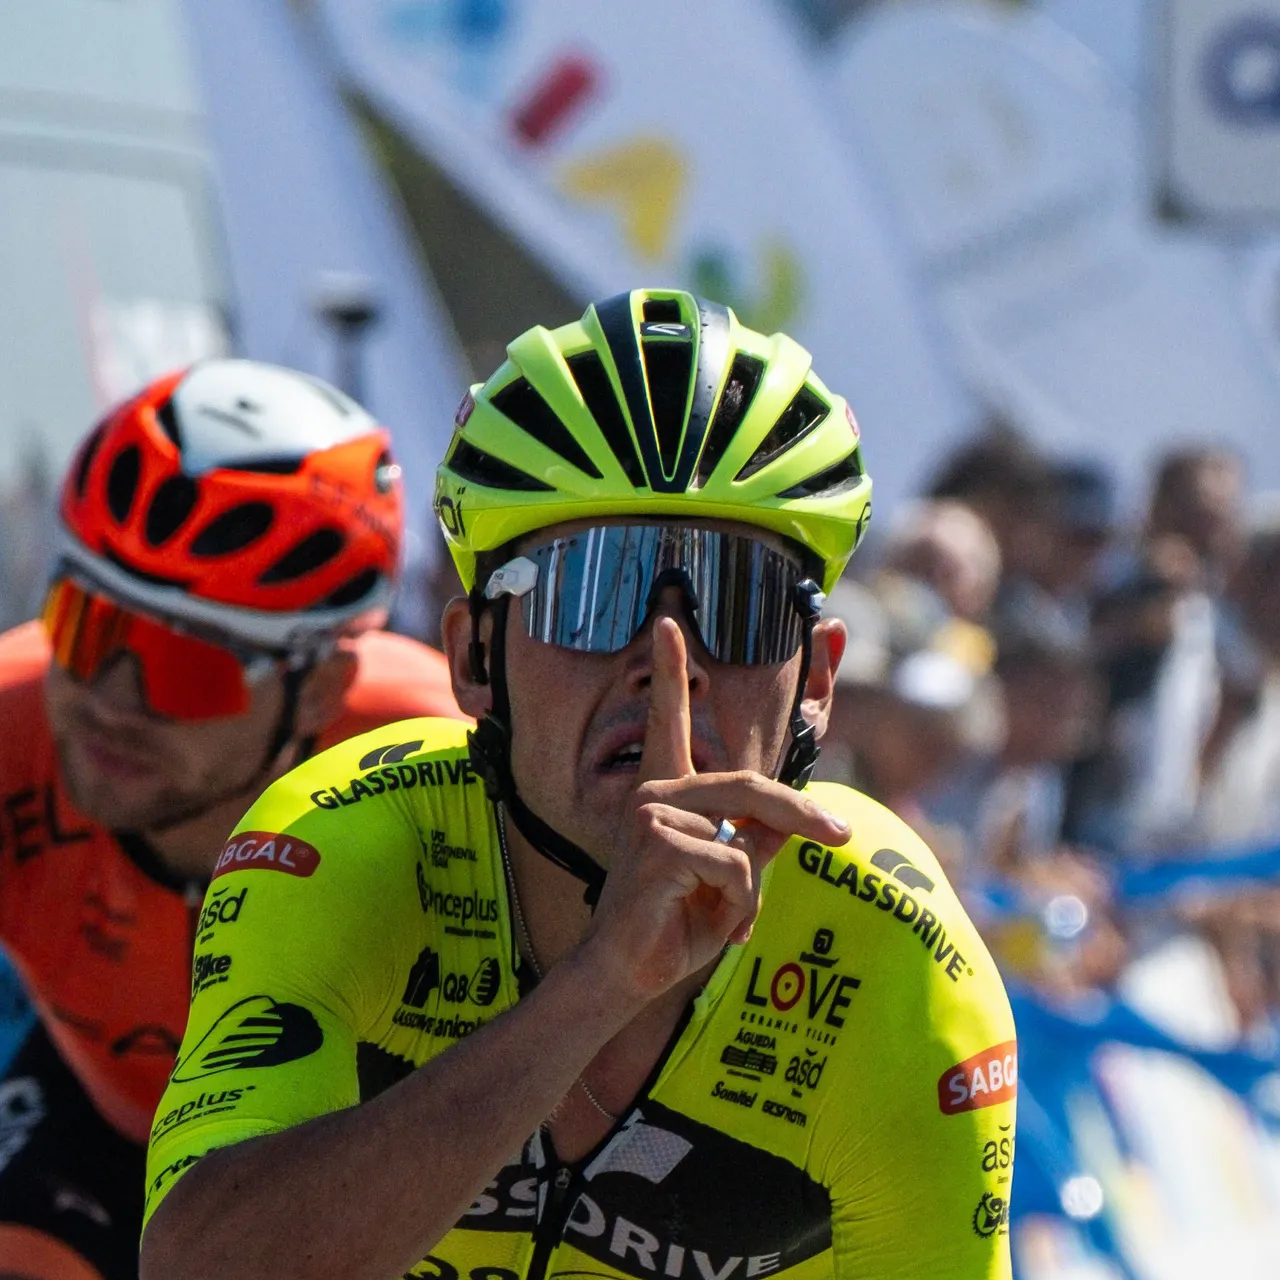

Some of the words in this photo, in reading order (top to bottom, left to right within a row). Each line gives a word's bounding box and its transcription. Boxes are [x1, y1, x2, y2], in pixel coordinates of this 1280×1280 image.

[311, 758, 477, 810] GLASSDRIVE
[797, 840, 967, 982] GLASSDRIVE
[745, 957, 861, 1029] LOVE
